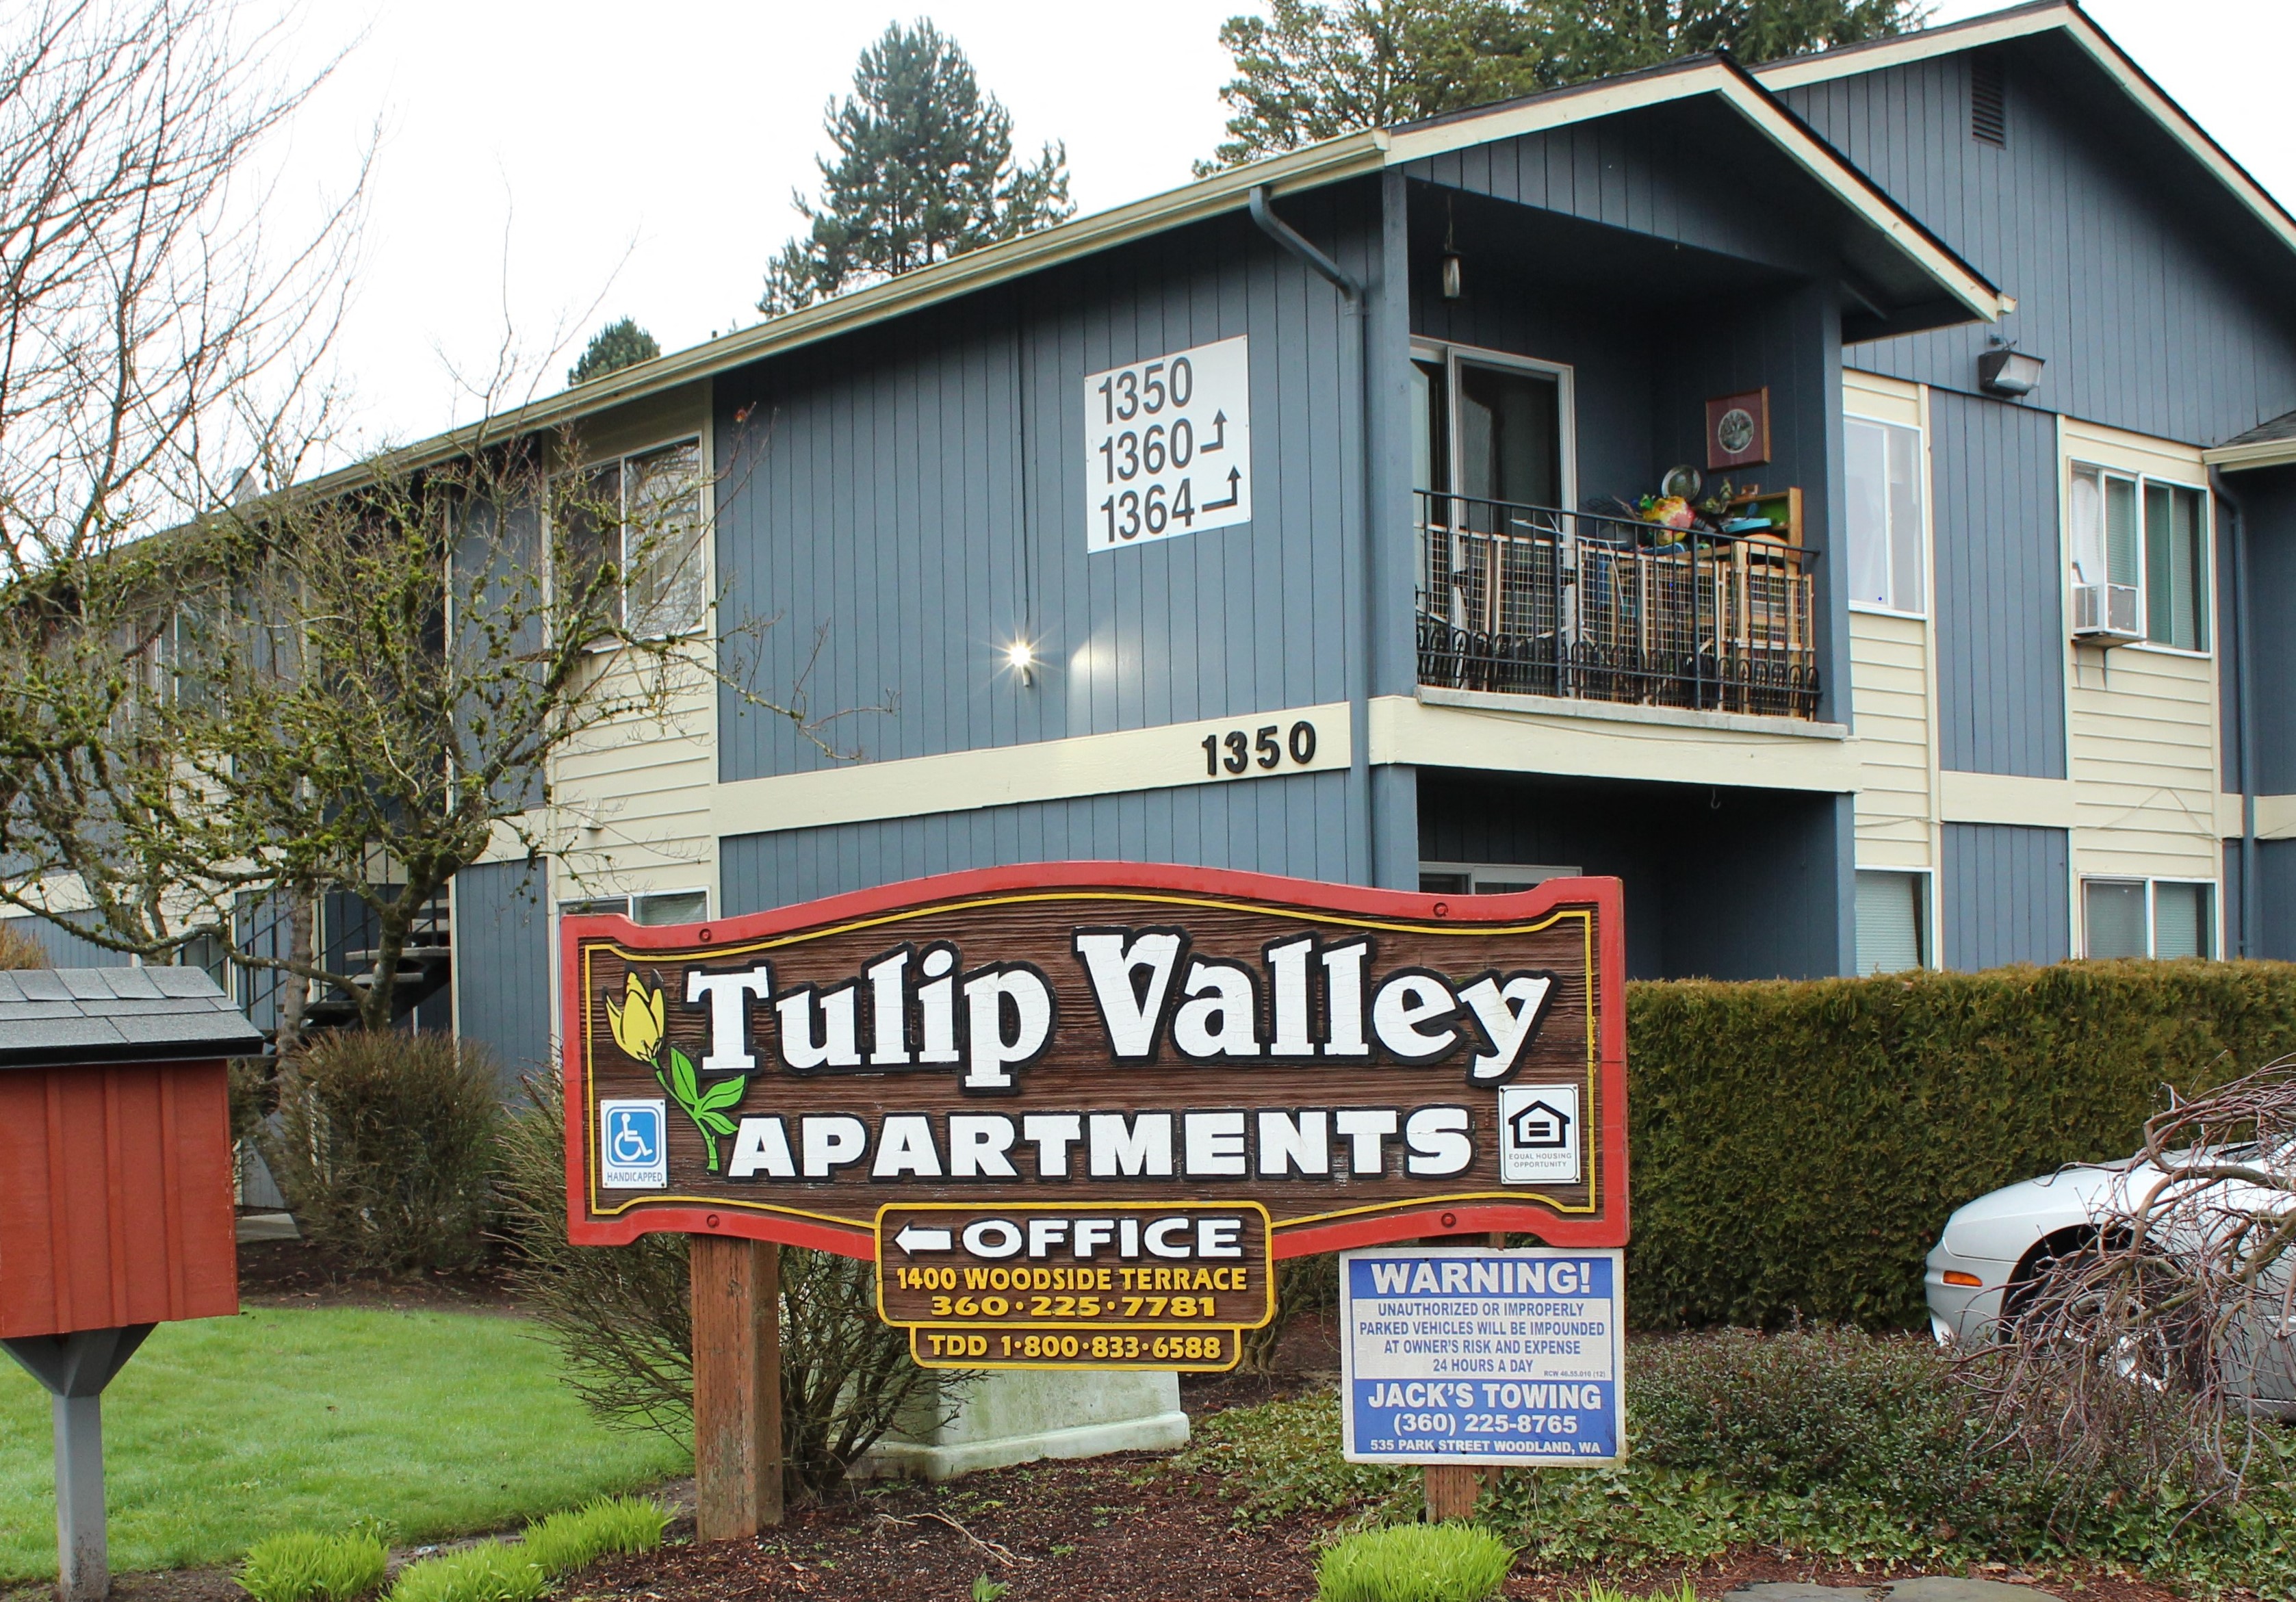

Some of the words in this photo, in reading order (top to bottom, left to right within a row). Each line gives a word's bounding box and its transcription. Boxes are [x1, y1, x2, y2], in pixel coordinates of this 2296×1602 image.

[1098, 357, 1193, 425] 1350
[1099, 417, 1194, 485] 1360
[1100, 477, 1195, 543] 1364
[1202, 721, 1317, 775] 1350
[686, 948, 1052, 1089] Tulip
[1076, 933, 1552, 1080] Valley
[727, 1107, 1472, 1178] APARTMENTS
[607, 1172, 662, 1182] HANDICAPPED
[962, 1218, 1242, 1258] OFFICE
[897, 1267, 957, 1290] 1400
[964, 1267, 1112, 1291] WOODSIDE
[1119, 1267, 1247, 1291] TERRACE
[1371, 1261, 1590, 1294] WARNING!
[1378, 1302, 1478, 1316] UNAUTHORIZED
[1482, 1303, 1500, 1316] OR
[1504, 1303, 1584, 1317] IMPROPERLY
[1360, 1321, 1408, 1335] PARKED
[1413, 1321, 1473, 1335] VEHICLES
[1477, 1321, 1506, 1335] WILL
[1510, 1321, 1526, 1335] BE
[1530, 1321, 1605, 1336] IMPOUNDED
[928, 1335, 988, 1356] TDD
[1384, 1340, 1399, 1354] AT
[1463, 1339, 1491, 1354] RISK
[1495, 1340, 1520, 1354] AND
[1525, 1340, 1581, 1354] EXPENSE
[1433, 1358, 1447, 1372] 24
[1452, 1358, 1494, 1372] HOURS
[1498, 1359, 1506, 1372] A
[1510, 1359, 1533, 1373] DAY
[1482, 1383, 1601, 1410] TOWING
[1393, 1413, 1456, 1437] (360)
[1465, 1413, 1577, 1434] 225-8765
[1371, 1439, 1394, 1451] 535
[1398, 1439, 1435, 1451] PARK
[1438, 1439, 1491, 1451] STREET
[1493, 1440, 1575, 1456] WOODLAND,
[1578, 1442, 1601, 1454] WA
